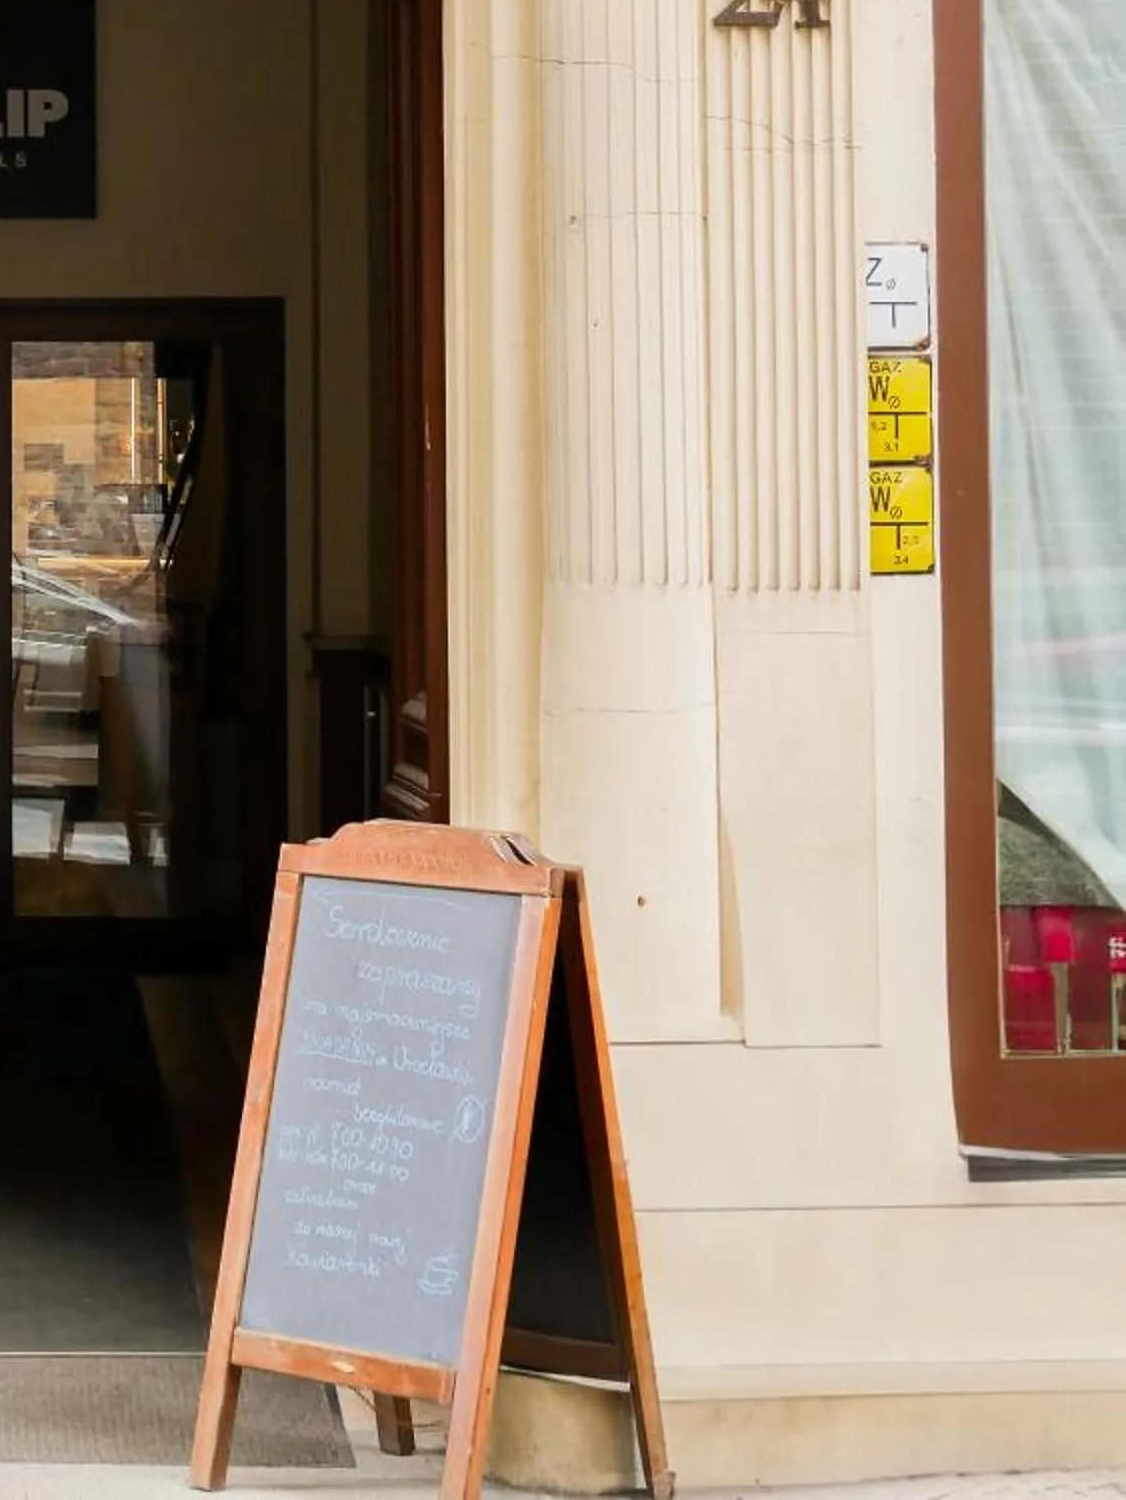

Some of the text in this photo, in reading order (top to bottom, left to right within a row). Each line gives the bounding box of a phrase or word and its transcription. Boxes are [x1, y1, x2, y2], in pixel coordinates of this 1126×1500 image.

[865, 257, 883, 287] Z
[869, 361, 902, 373] GAZ
[868, 375, 890, 402] W
[869, 471, 903, 484] GAZ
[869, 485, 891, 513] W
